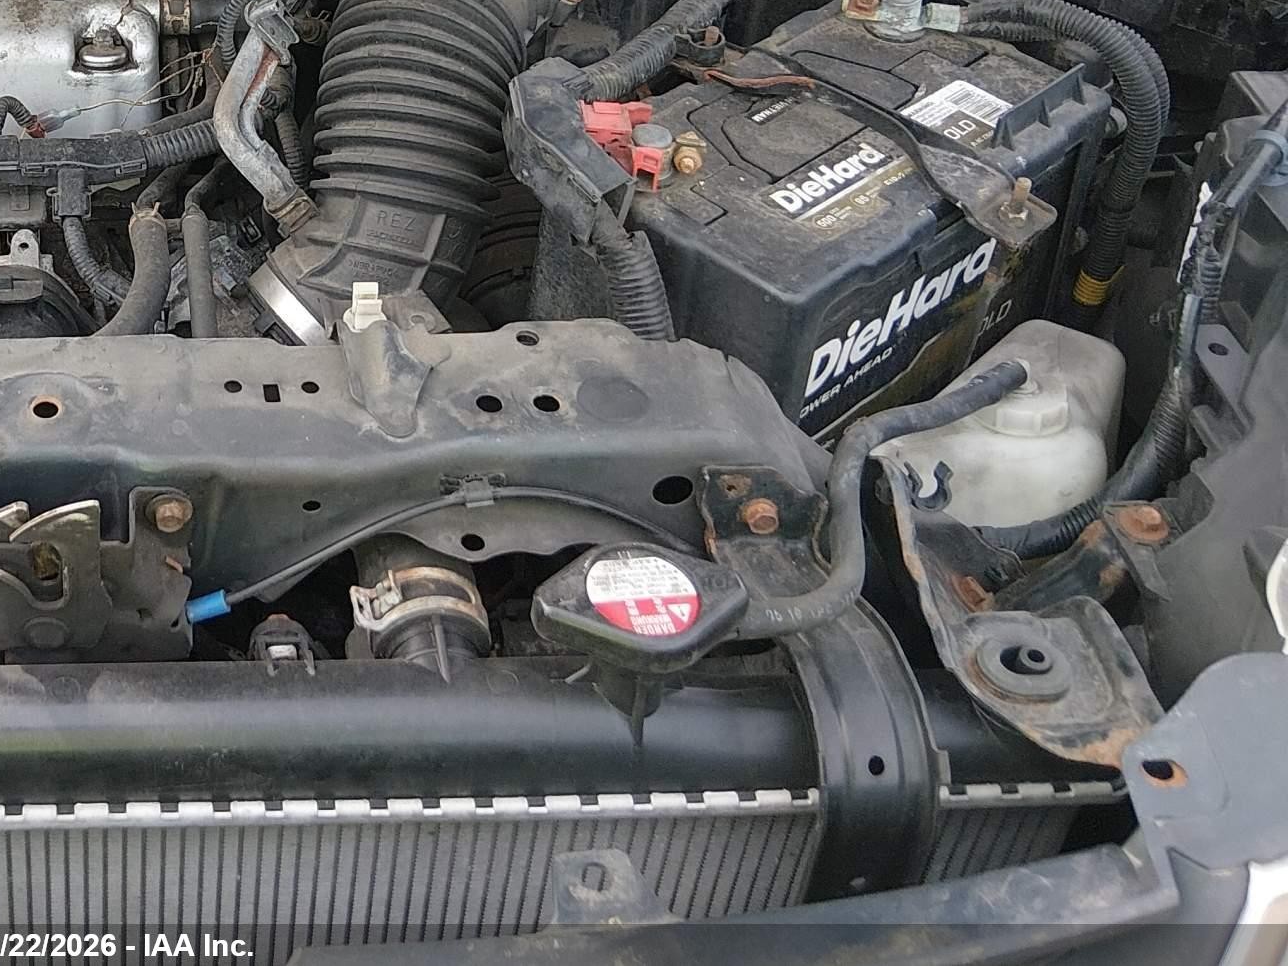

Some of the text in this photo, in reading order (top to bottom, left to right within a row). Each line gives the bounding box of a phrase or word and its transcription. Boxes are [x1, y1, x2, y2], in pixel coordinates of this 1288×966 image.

[943, 119, 977, 140] OLD
[769, 143, 886, 213] DieHard
[804, 237, 997, 397] DieHard
[799, 346, 894, 418] OWER AHEAD
